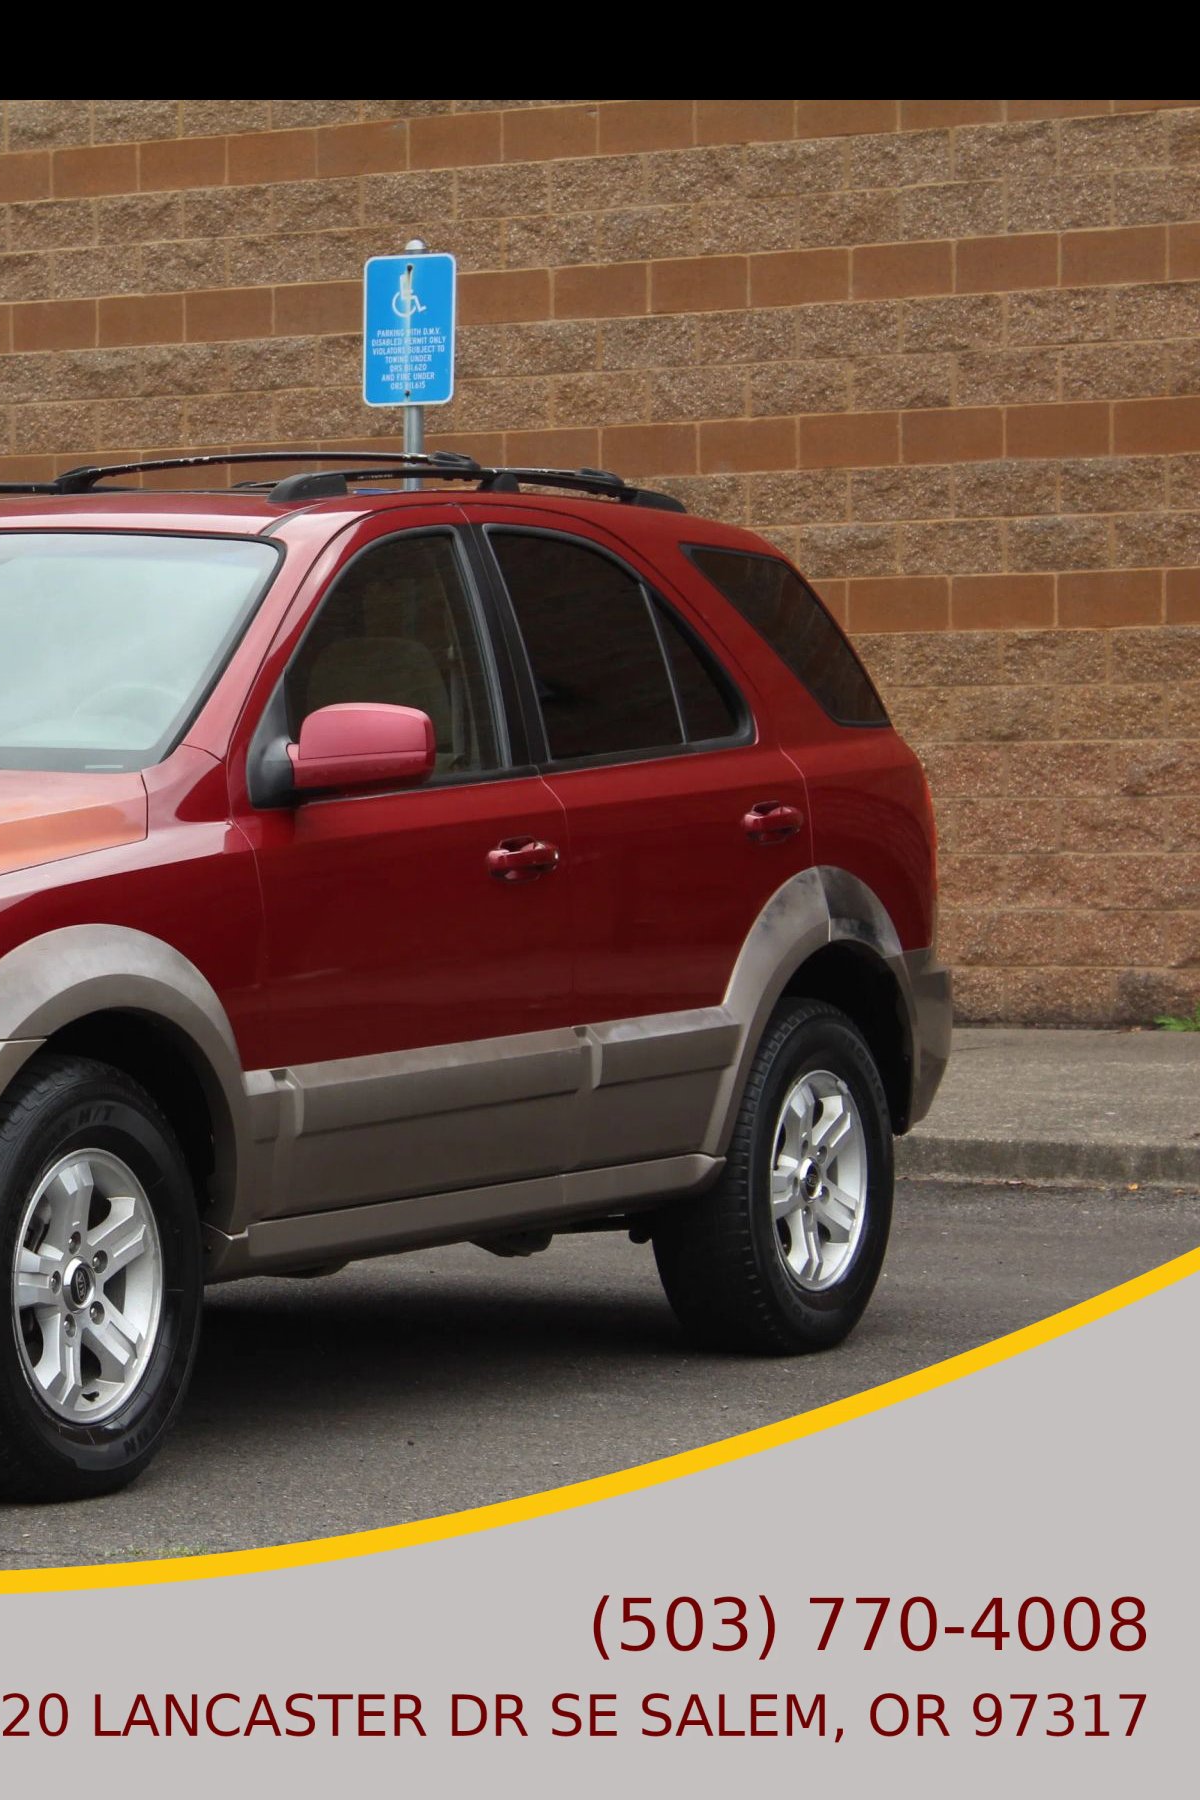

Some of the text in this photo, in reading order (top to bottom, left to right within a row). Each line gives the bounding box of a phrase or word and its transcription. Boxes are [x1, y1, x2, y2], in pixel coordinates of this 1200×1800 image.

[429, 336, 446, 344] ONLY
[437, 344, 445, 352] TO
[410, 354, 432, 363] UNDER
[381, 373, 394, 382] AND
[413, 372, 435, 380] UNDER
